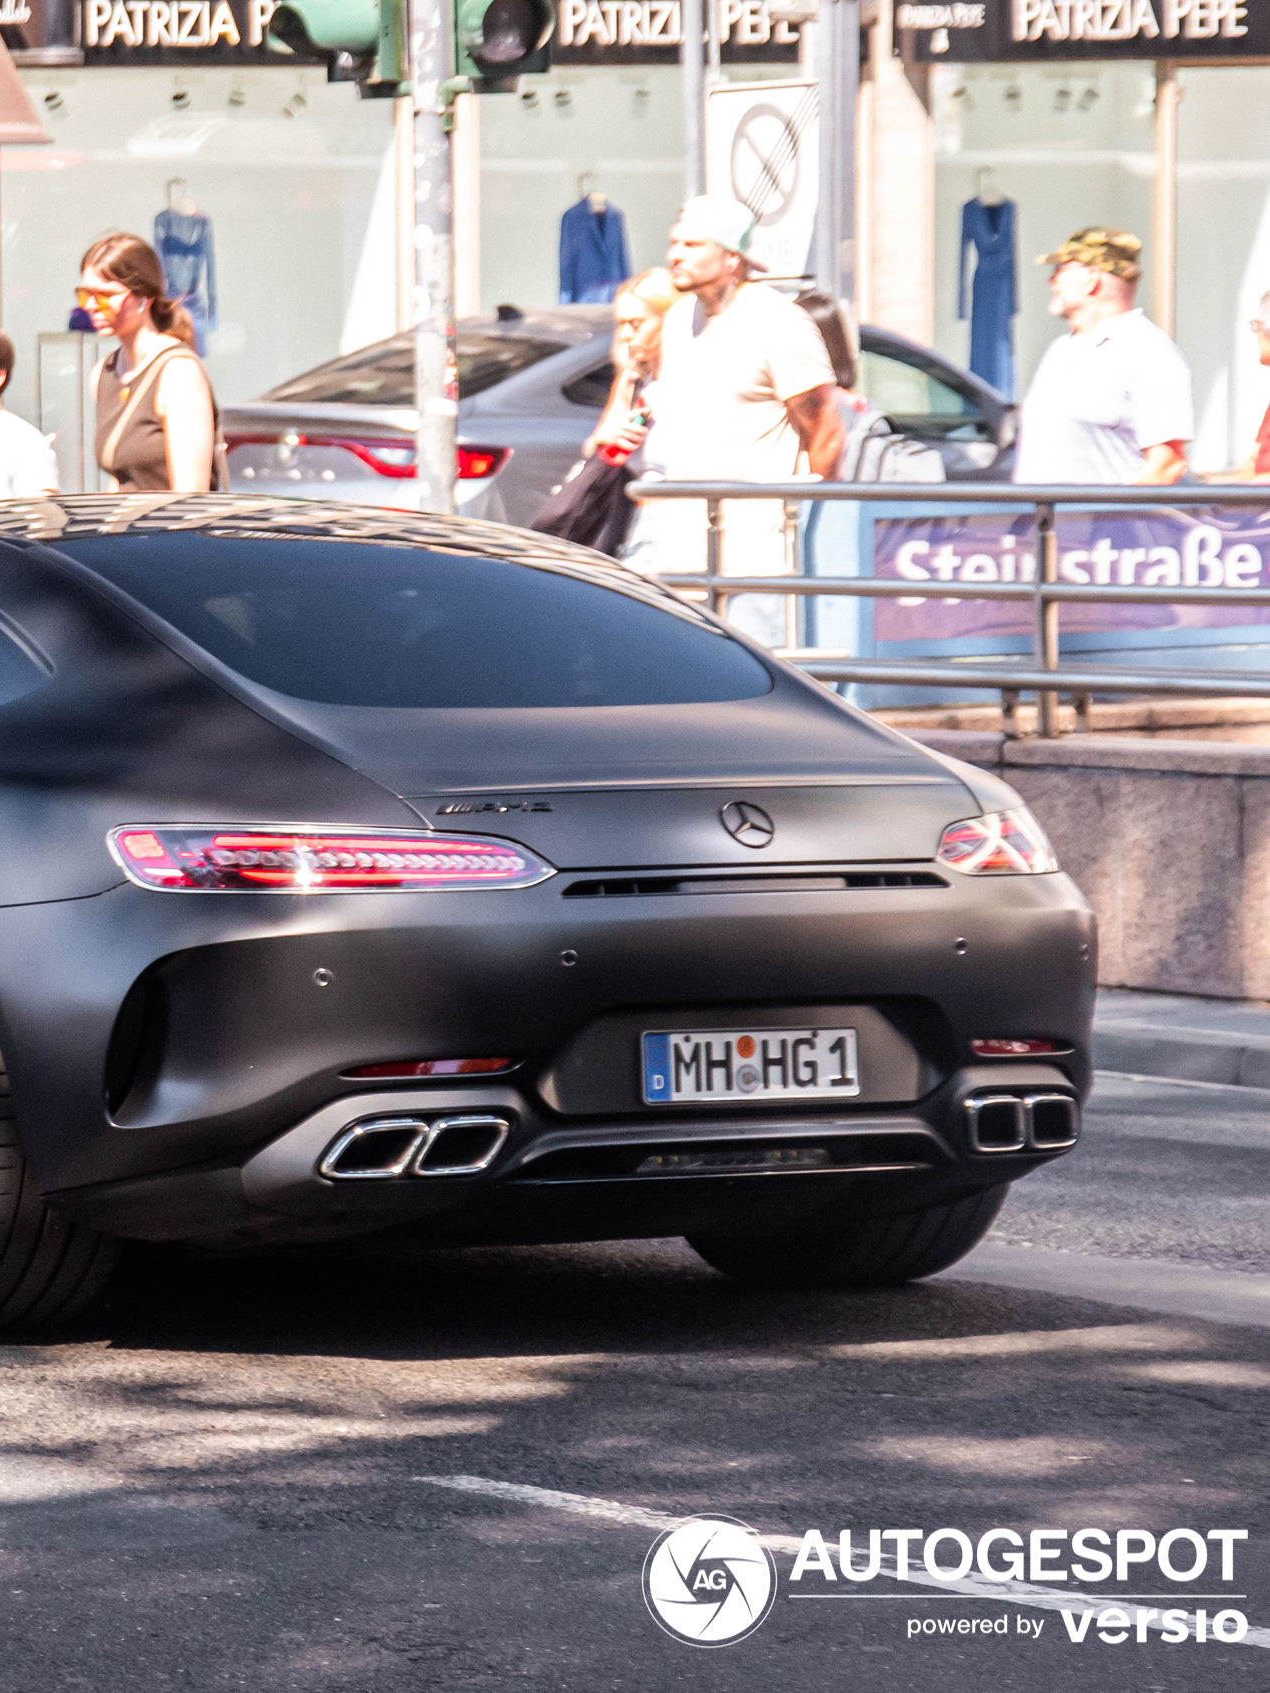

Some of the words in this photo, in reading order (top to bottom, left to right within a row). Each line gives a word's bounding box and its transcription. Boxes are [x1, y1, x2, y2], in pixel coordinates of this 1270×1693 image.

[86, 0, 241, 47] PATRIZIA
[558, 0, 710, 47] PATRIZI
[1012, 0, 1160, 42] PATRIZIA
[1163, 0, 1249, 38] PEPE
[652, 1075, 664, 1090] D
[673, 1041, 734, 1093] MH
[761, 1037, 819, 1089] HG
[829, 1036, 855, 1087] 1
